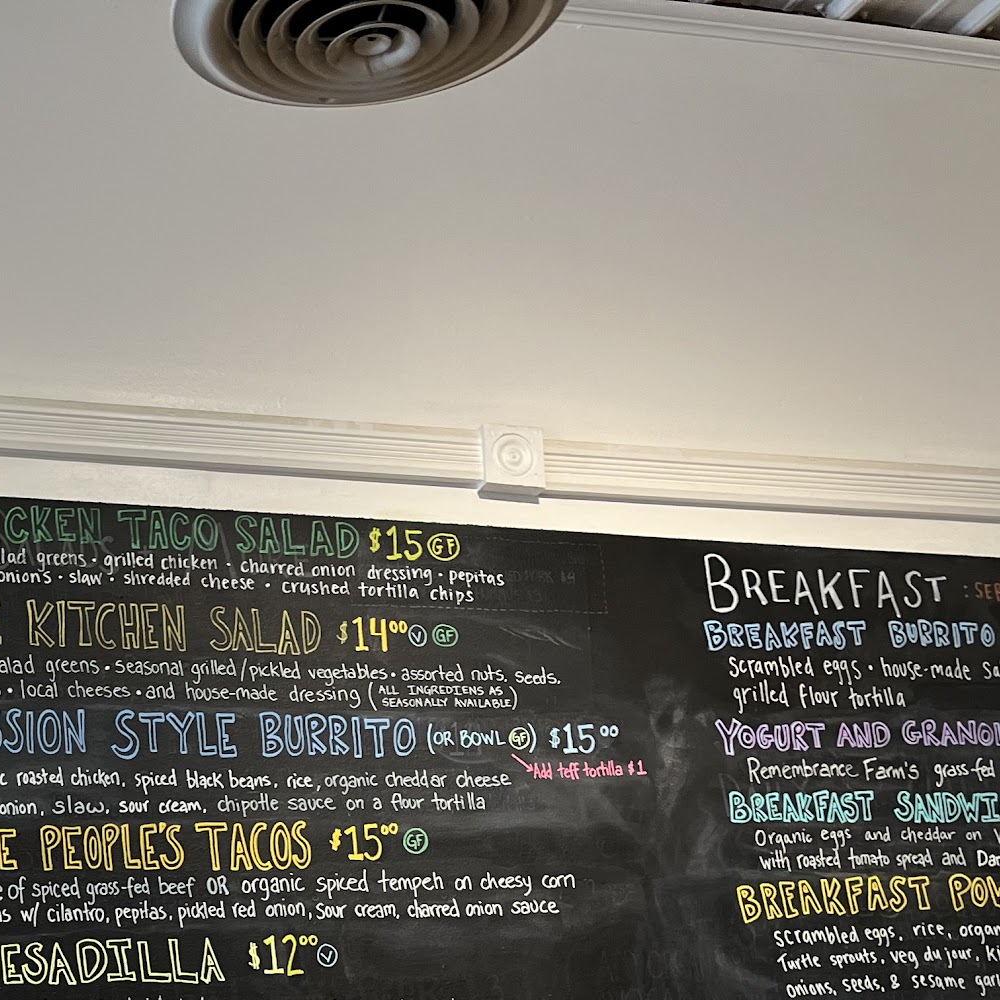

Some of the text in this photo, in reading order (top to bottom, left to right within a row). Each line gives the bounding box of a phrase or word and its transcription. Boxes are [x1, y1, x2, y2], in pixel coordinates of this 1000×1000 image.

[117, 508, 219, 552] TACO
[234, 514, 360, 559] SALAD
[368, 524, 425, 561] $15
[703, 552, 948, 619] BREAKFAST
[25, 599, 187, 652] KITCHEN
[209, 604, 322, 655] SALAD
[703, 618, 996, 651] BREAKFAST BURRITO
[378, 685, 399, 696] ALL
[488, 685, 504, 696] AS
[381, 697, 513, 709] SEASONALLY AVAILABLE
[110, 709, 238, 760] STYLE
[258, 710, 417, 759] BURRITO
[714, 717, 826, 756] YOGURT
[836, 721, 892, 749] AND
[533, 760, 648, 780] Add teff tortilla $1
[38, 822, 185, 872] PEOPLE'S
[194, 820, 313, 871] TACOS
